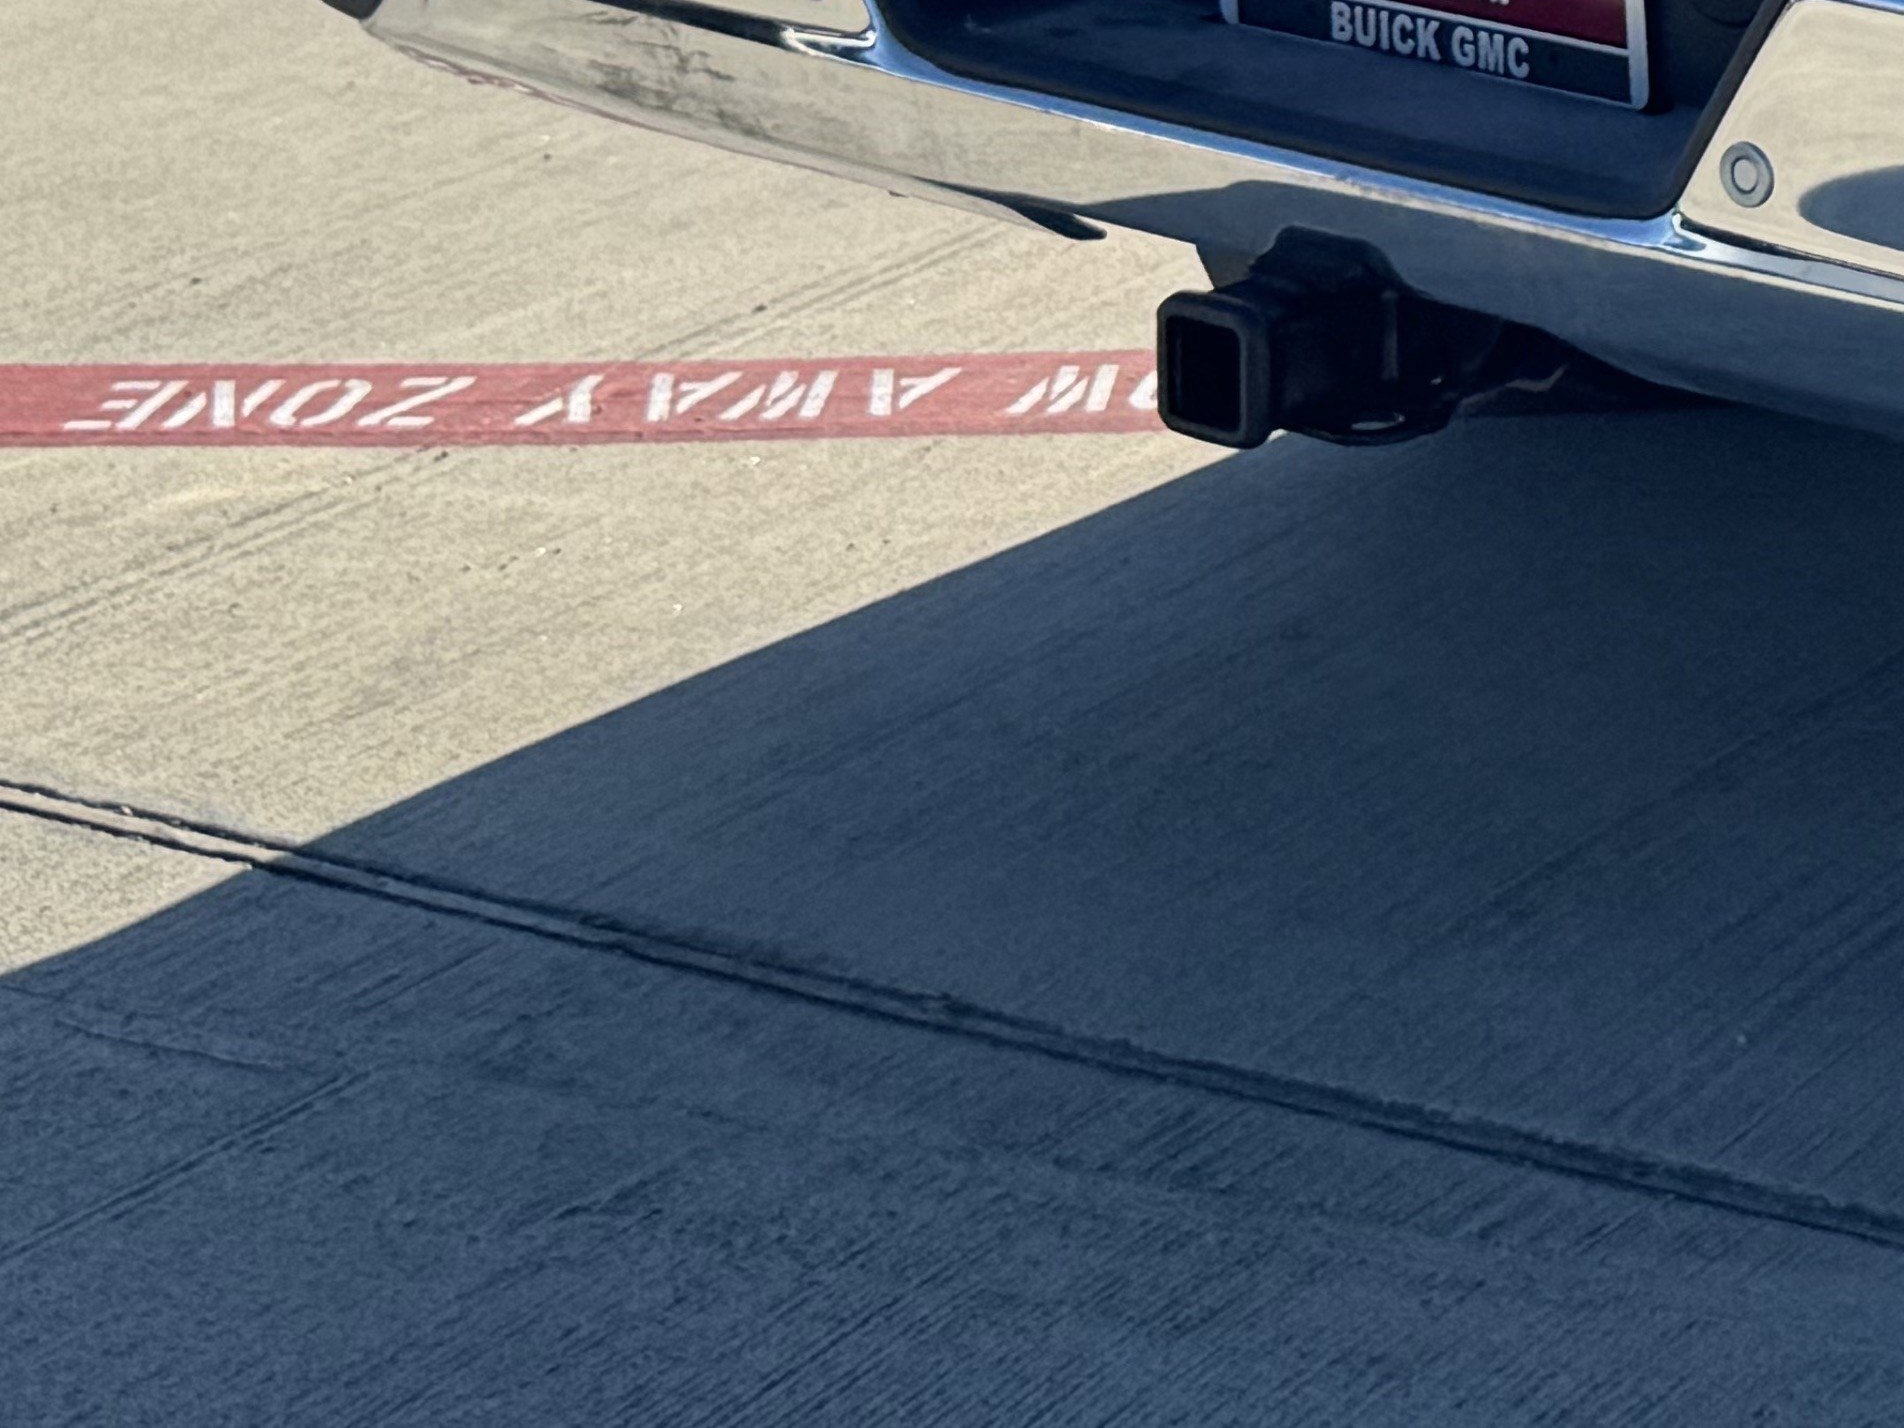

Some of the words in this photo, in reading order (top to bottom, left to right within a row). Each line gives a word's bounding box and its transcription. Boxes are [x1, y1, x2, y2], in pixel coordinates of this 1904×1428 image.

[1330, 0, 1441, 62] BUICK
[1452, 26, 1531, 79] GMC
[61, 376, 478, 431] ZONE
[514, 367, 963, 426] AWAY
